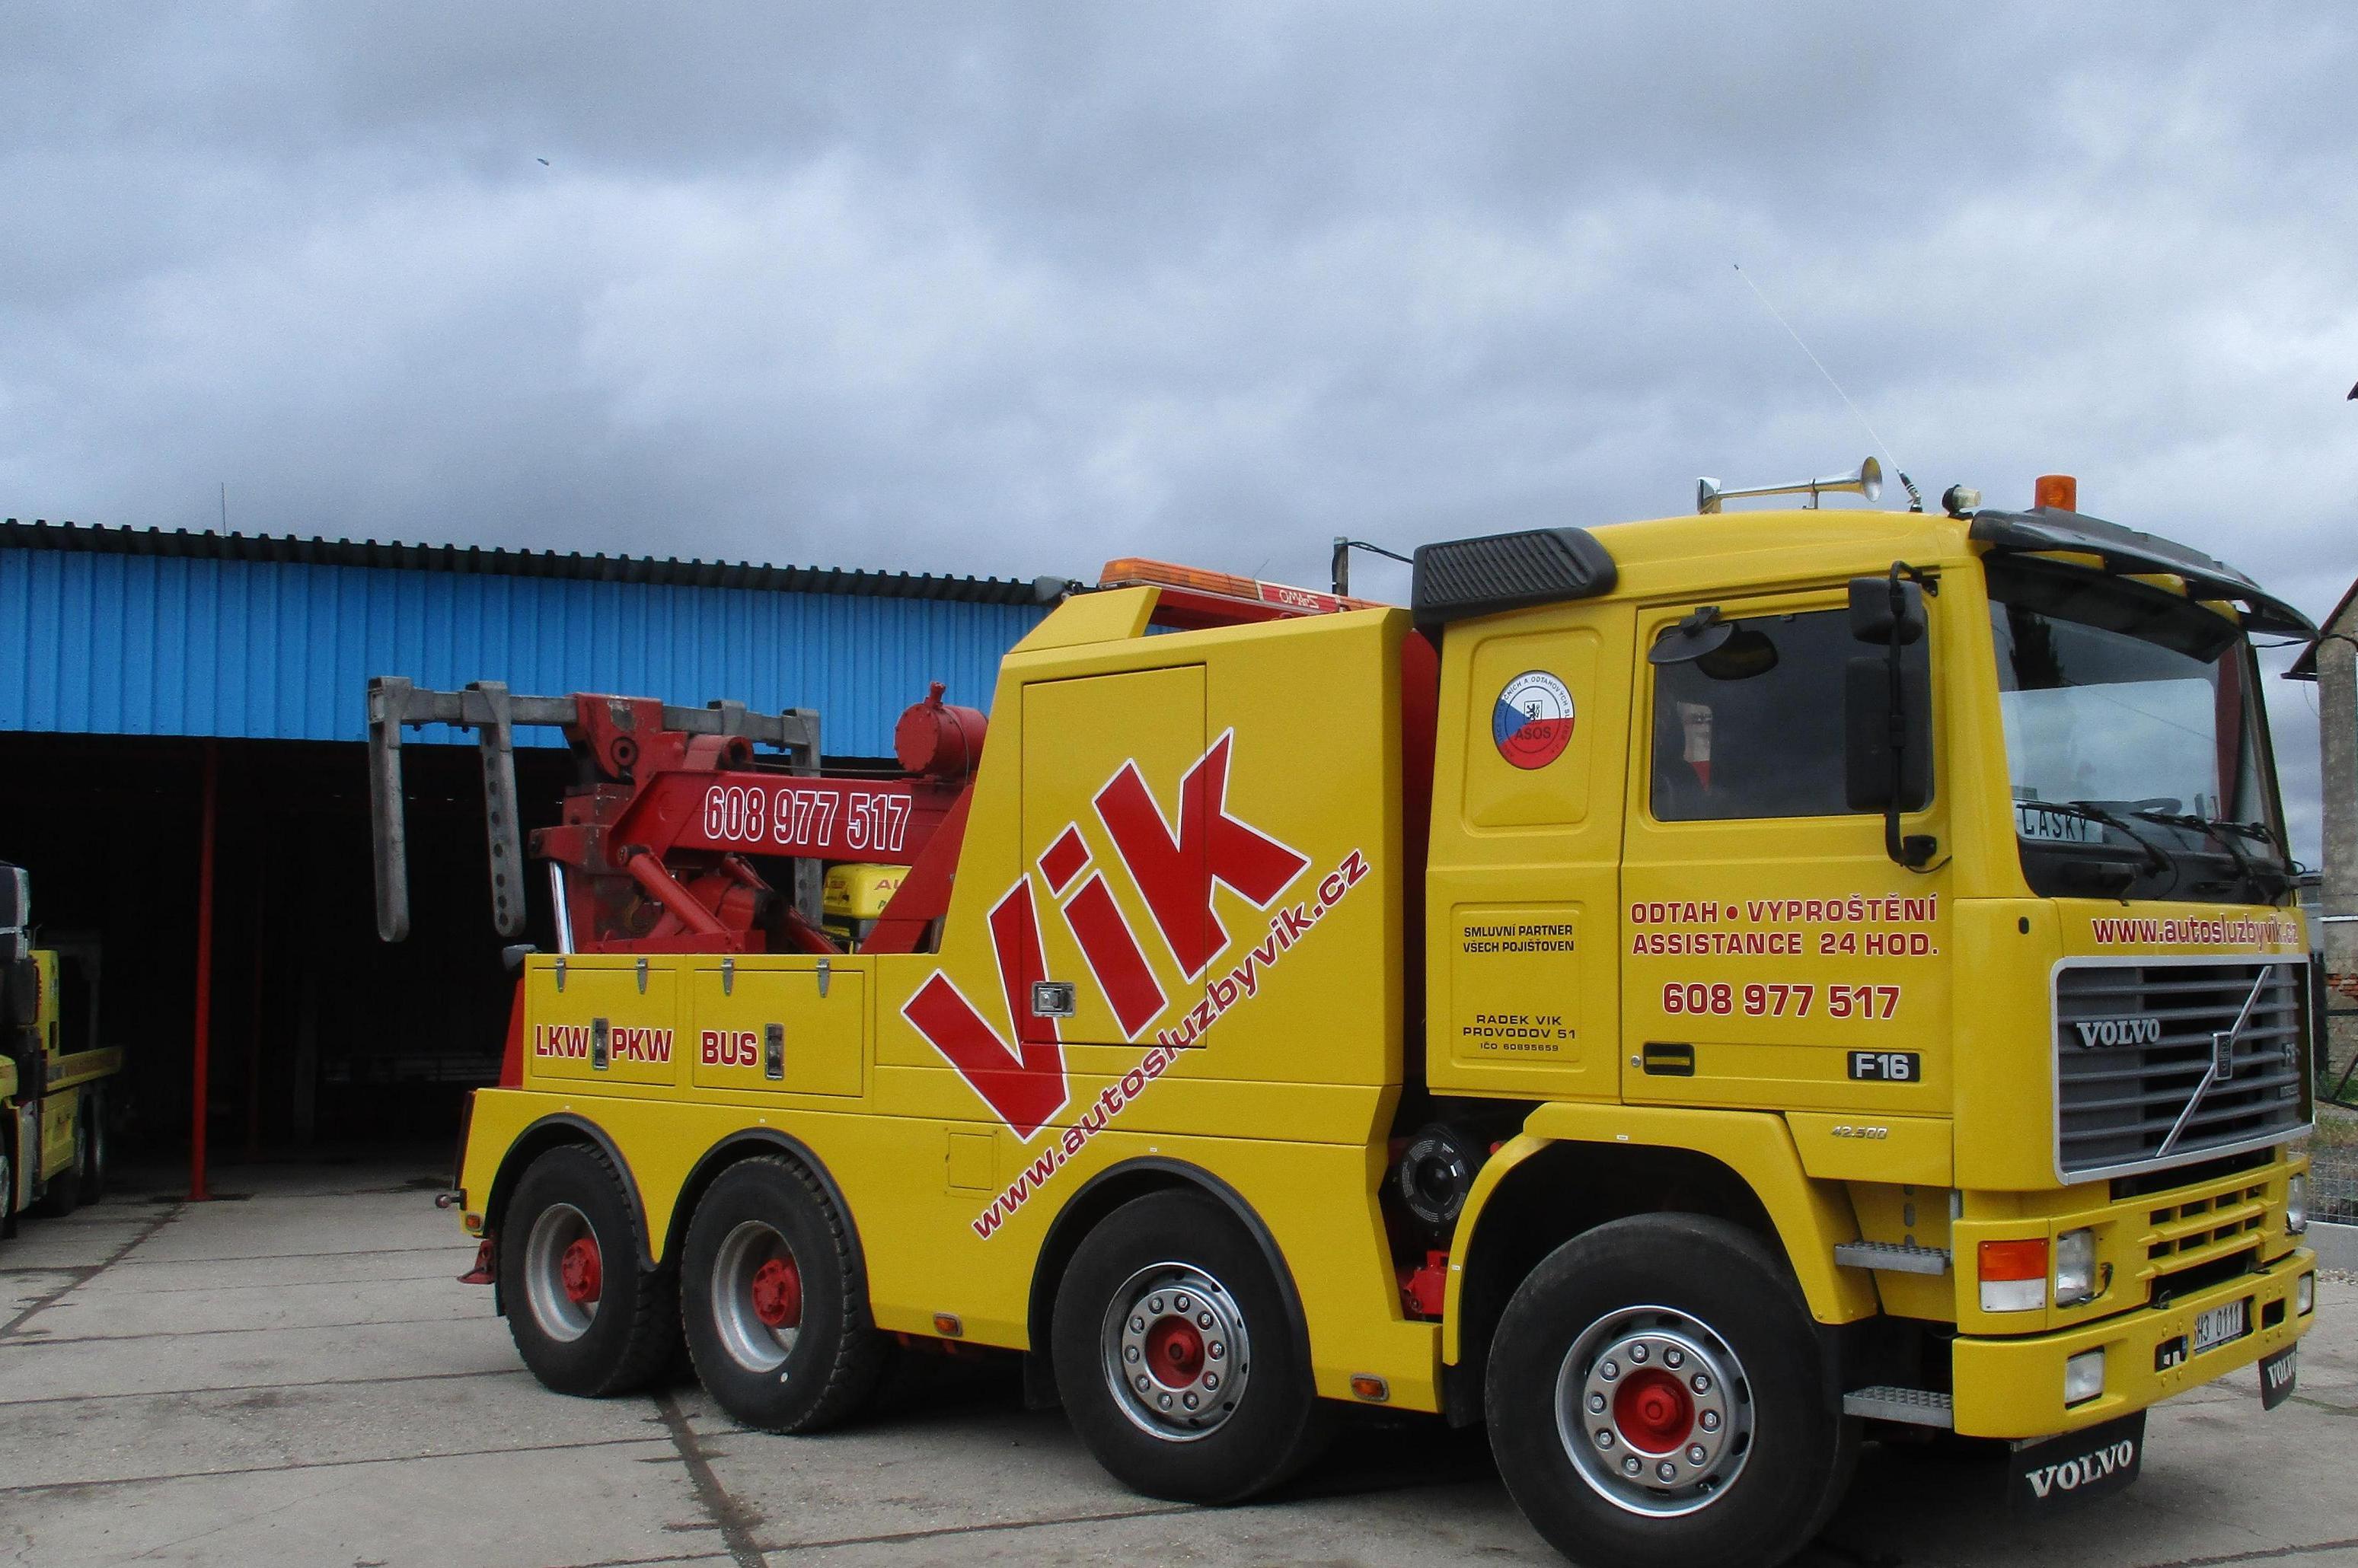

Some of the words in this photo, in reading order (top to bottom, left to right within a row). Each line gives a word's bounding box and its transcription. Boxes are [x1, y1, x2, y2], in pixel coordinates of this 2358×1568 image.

[1514, 726, 1552, 741] ASOS
[704, 786, 765, 842] 608
[774, 789, 839, 846] 977
[847, 792, 912, 852] 517
[1630, 901, 1718, 924] ODTAH
[1747, 893, 1938, 923] VYPROŠTĚNÍ
[1463, 924, 1516, 937] SMLUVNÍ
[1518, 924, 1573, 936] PARTNER
[1632, 932, 1803, 955] ASSISTANCE
[1819, 932, 1856, 955] 24
[1865, 932, 1939, 957] HOD.
[2090, 913, 2299, 951] www.autosluzbyvik.cz
[1463, 940, 1499, 953] VŠECH
[1502, 939, 1575, 952] POJIŠŤOVEN
[1662, 981, 1733, 1015] 608
[1743, 983, 1814, 1018] 977
[1828, 984, 1901, 1020] 517
[1463, 1028, 1551, 1039] PROVODOV
[1558, 1029, 1576, 1040] 51
[1476, 1014, 1530, 1025] RADEK
[1536, 1015, 1562, 1026] VIK
[2076, 1018, 2161, 1048] VOLVO
[536, 1024, 590, 1059] LKW
[611, 1027, 674, 1063] PKW
[701, 1030, 759, 1067] BUS
[971, 847, 1371, 1241] www.autosluzbyvik.cz
[1855, 1053, 1910, 1080] F16
[2216, 1302, 2239, 1337] 0111
[2025, 1439, 2133, 1498] VOLVO
